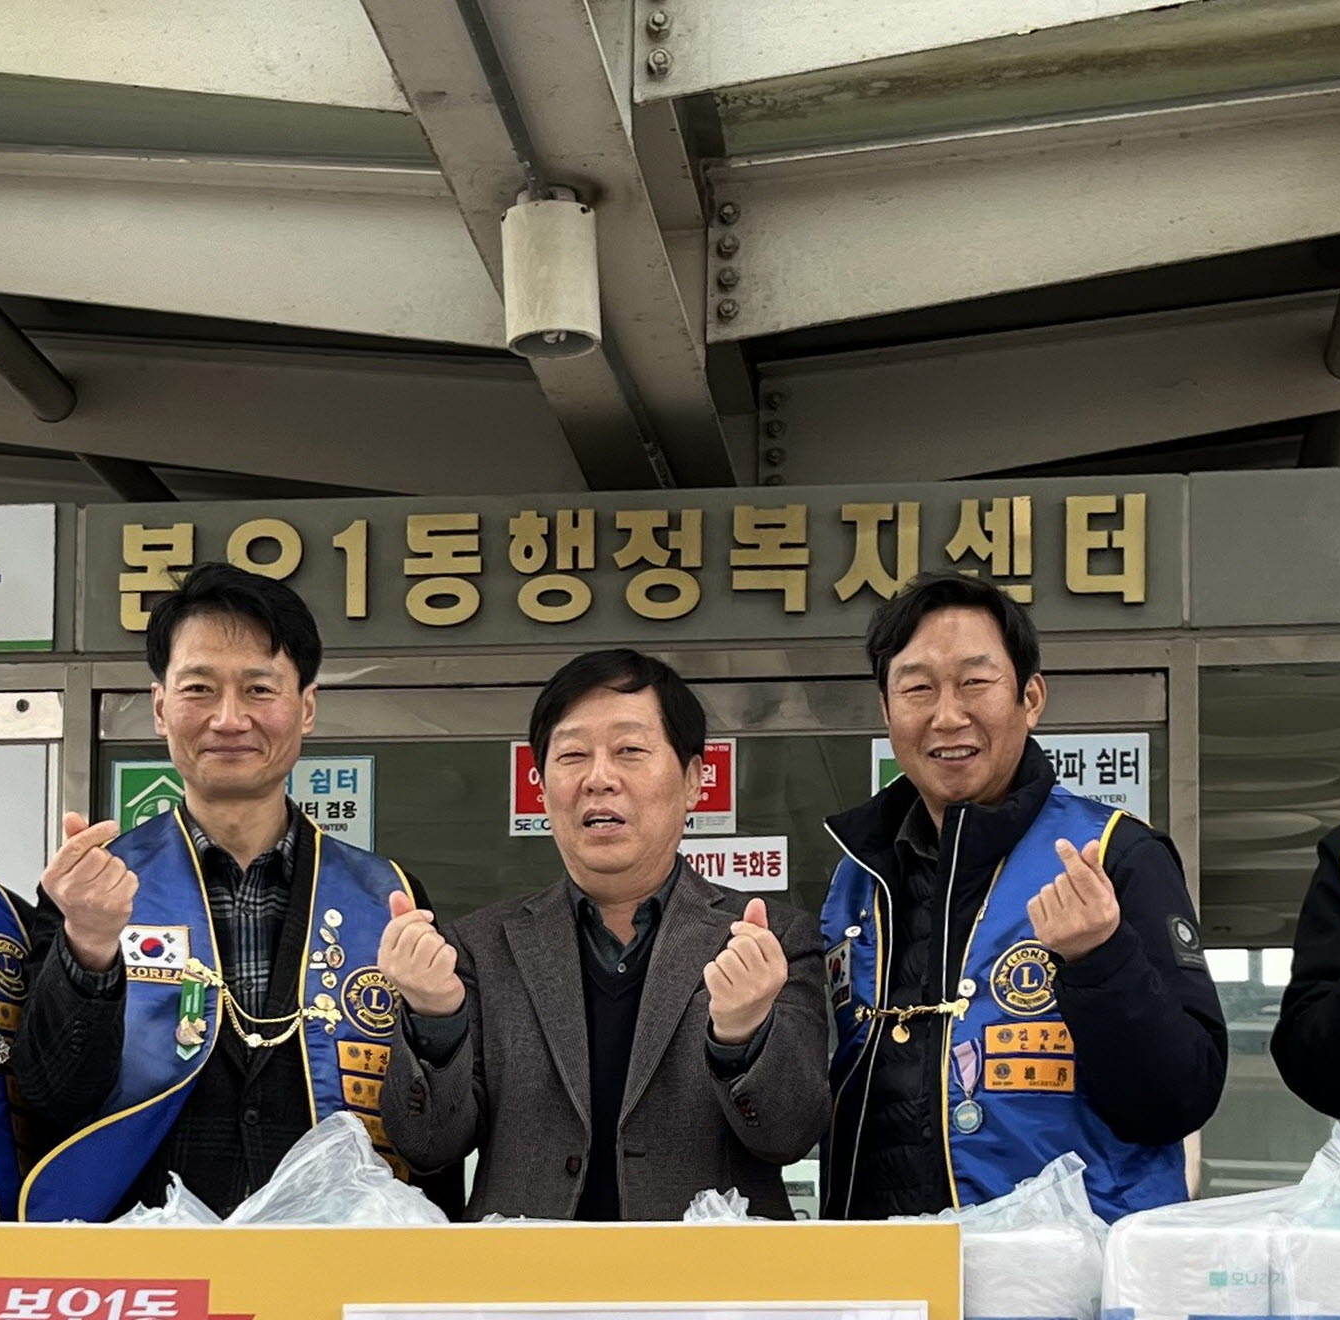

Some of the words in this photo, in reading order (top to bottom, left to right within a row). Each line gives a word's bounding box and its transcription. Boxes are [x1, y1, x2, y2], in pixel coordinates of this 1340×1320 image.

[1095, 747, 1140, 785] 쉼터
[309, 767, 358, 794] 쉼터
[324, 801, 358, 819] 겸용
[732, 851, 782, 878] 녹화중
[1020, 966, 1039, 988] L
